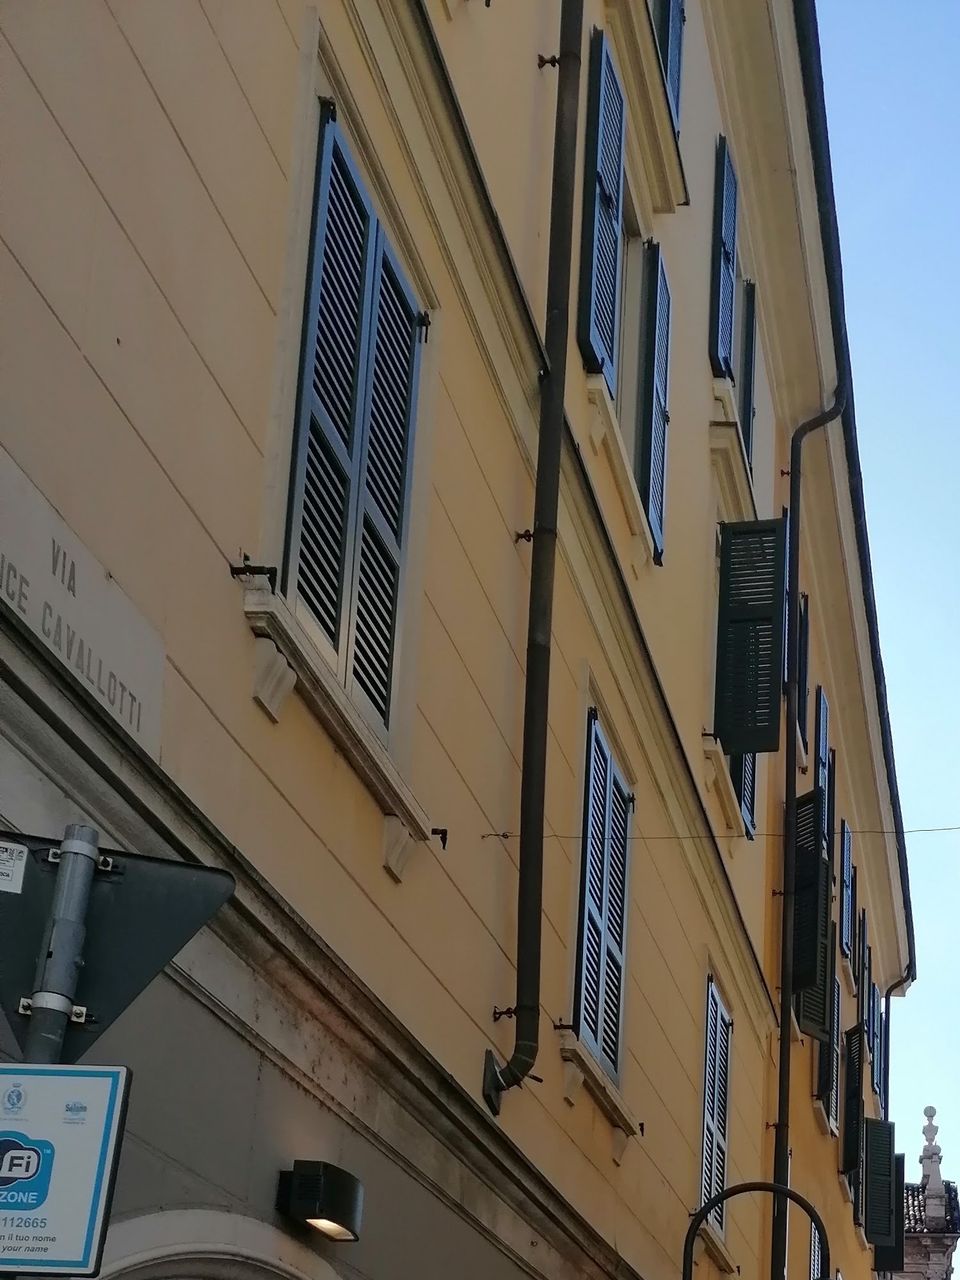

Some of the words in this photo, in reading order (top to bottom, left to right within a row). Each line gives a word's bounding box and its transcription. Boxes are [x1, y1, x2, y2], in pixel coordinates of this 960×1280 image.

[52, 537, 76, 598] VIA
[41, 601, 142, 733] CAVALLOTTI
[8, 1155, 32, 1173] Fi
[0, 1191, 38, 1204] ZONE
[7, 1233, 14, 1241] il
[15, 1234, 30, 1242] tuo
[1, 1245, 22, 1254] your
